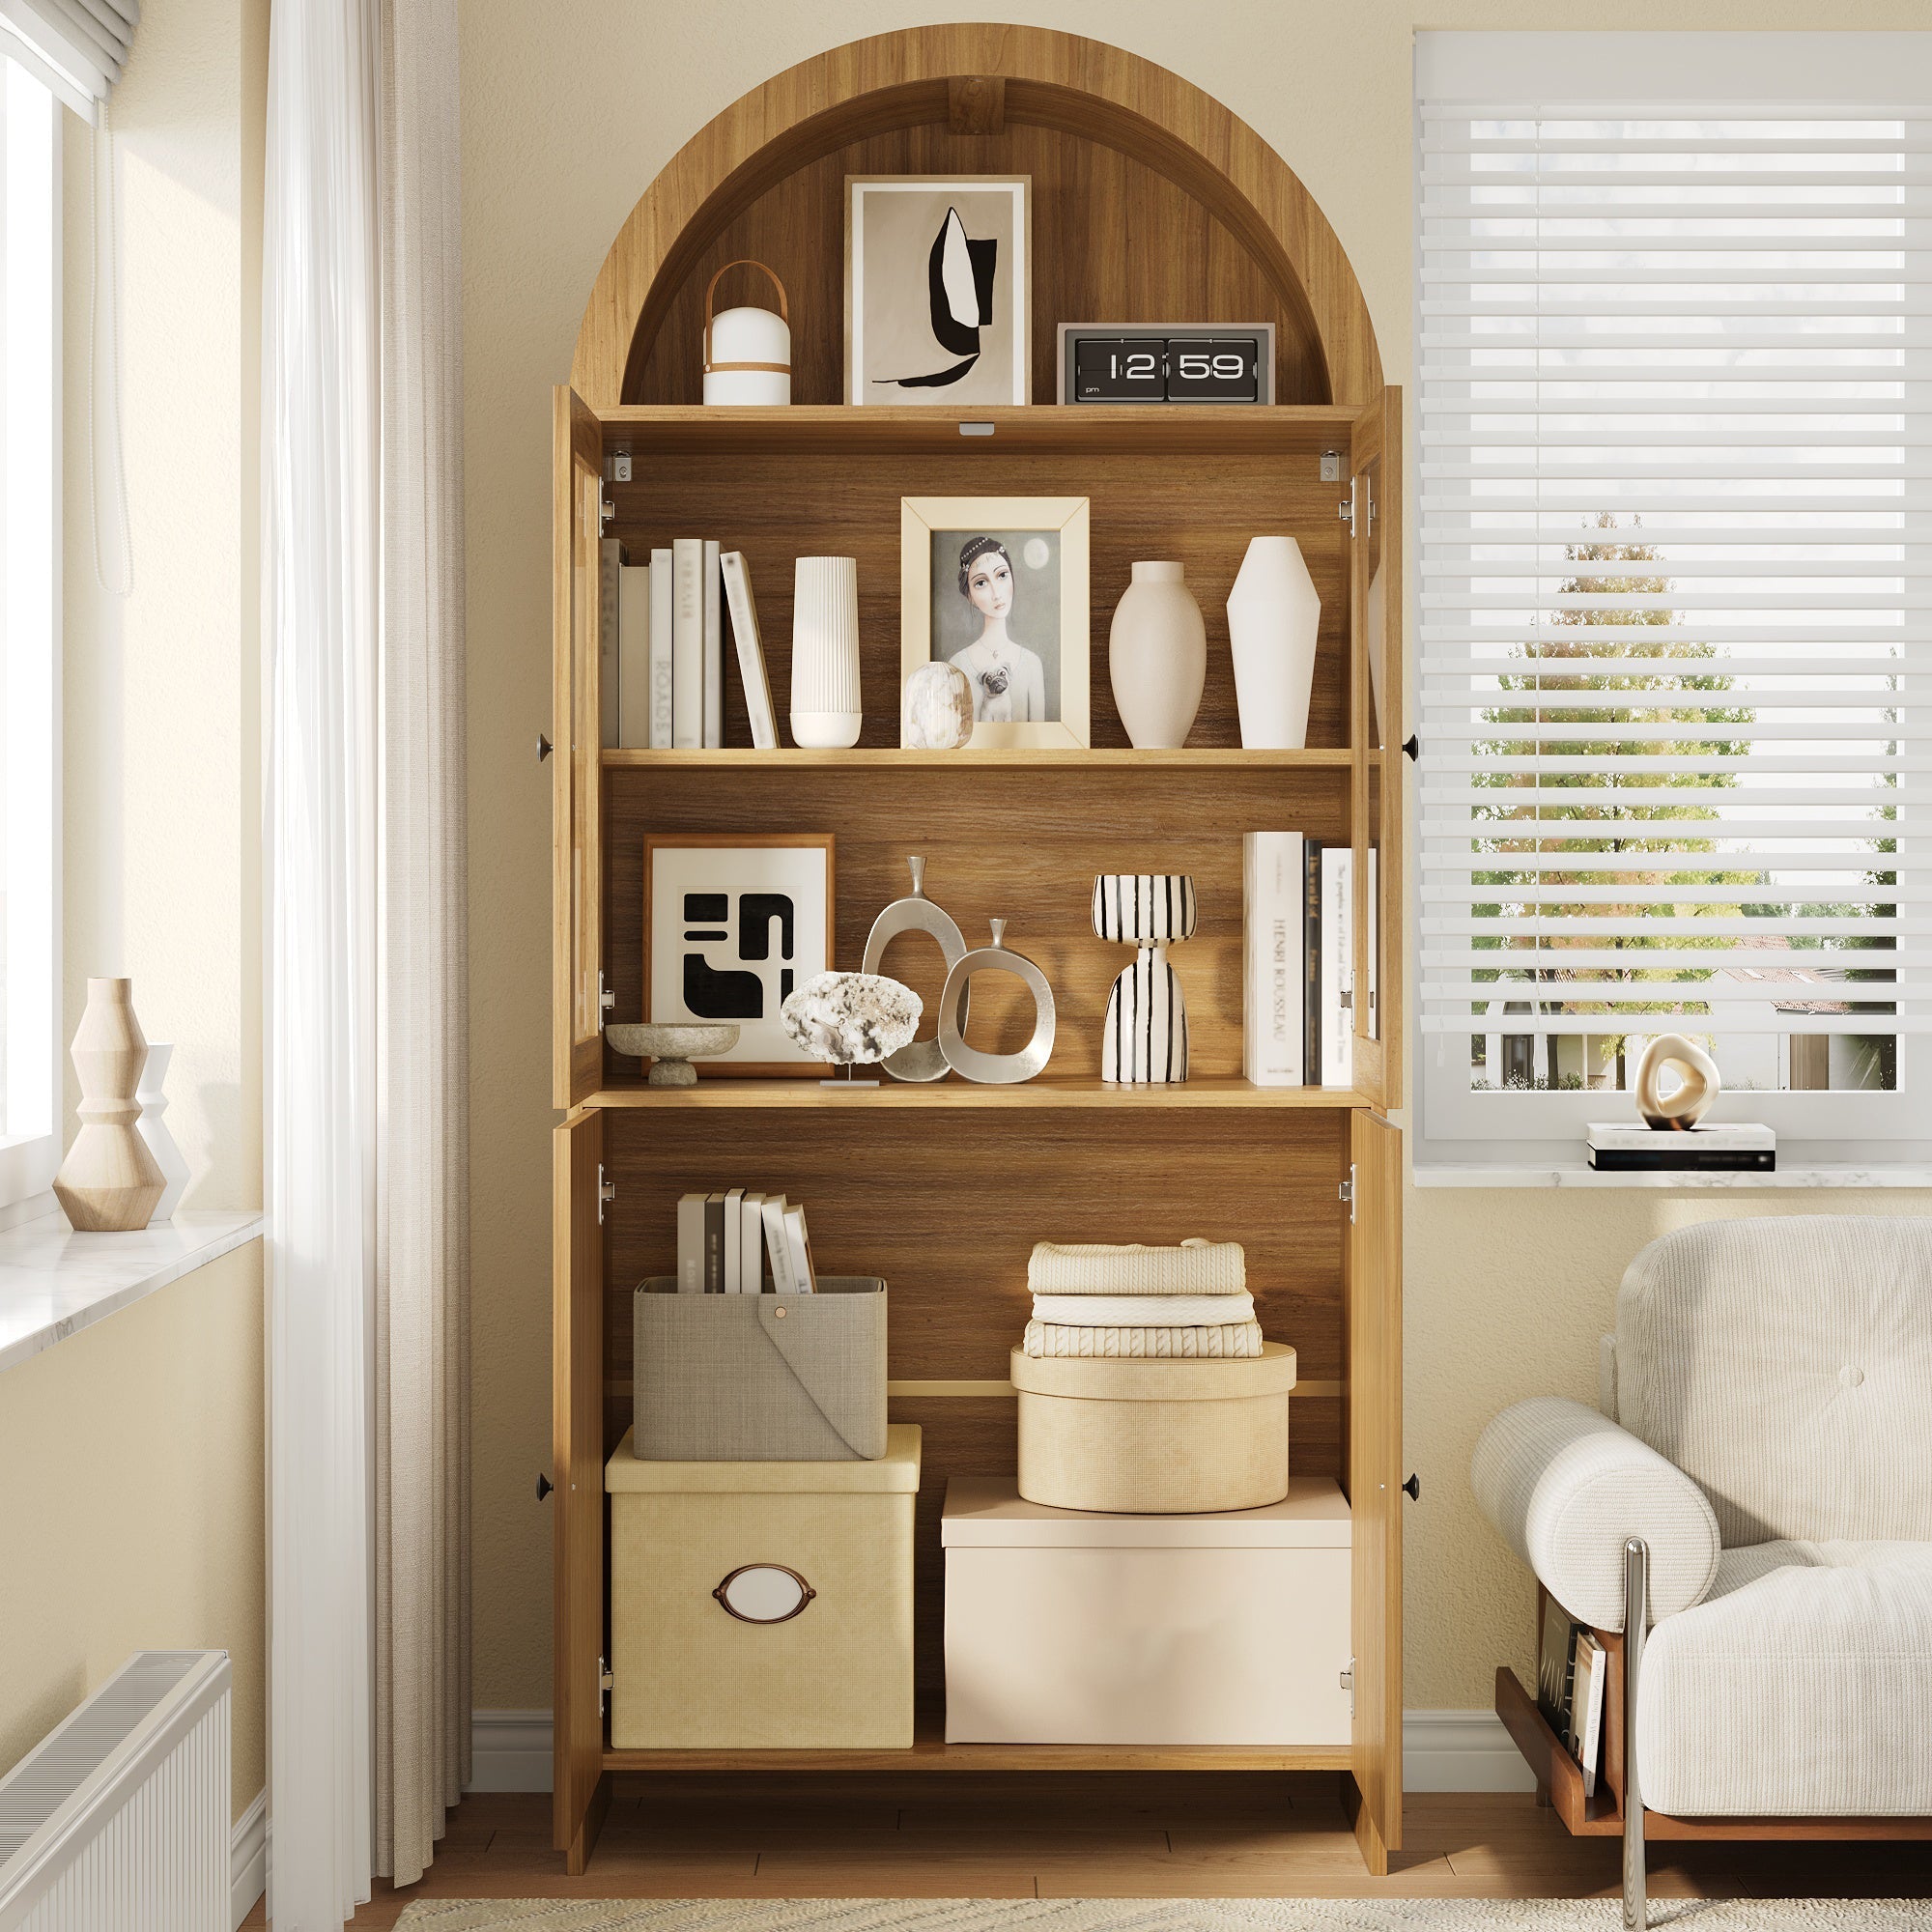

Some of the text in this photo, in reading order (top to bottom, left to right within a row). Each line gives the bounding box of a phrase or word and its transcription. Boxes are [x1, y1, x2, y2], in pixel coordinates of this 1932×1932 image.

[1111, 354, 1244, 380] 12 59
[1273, 919, 1286, 1042] HENRI ROUSSEAU
